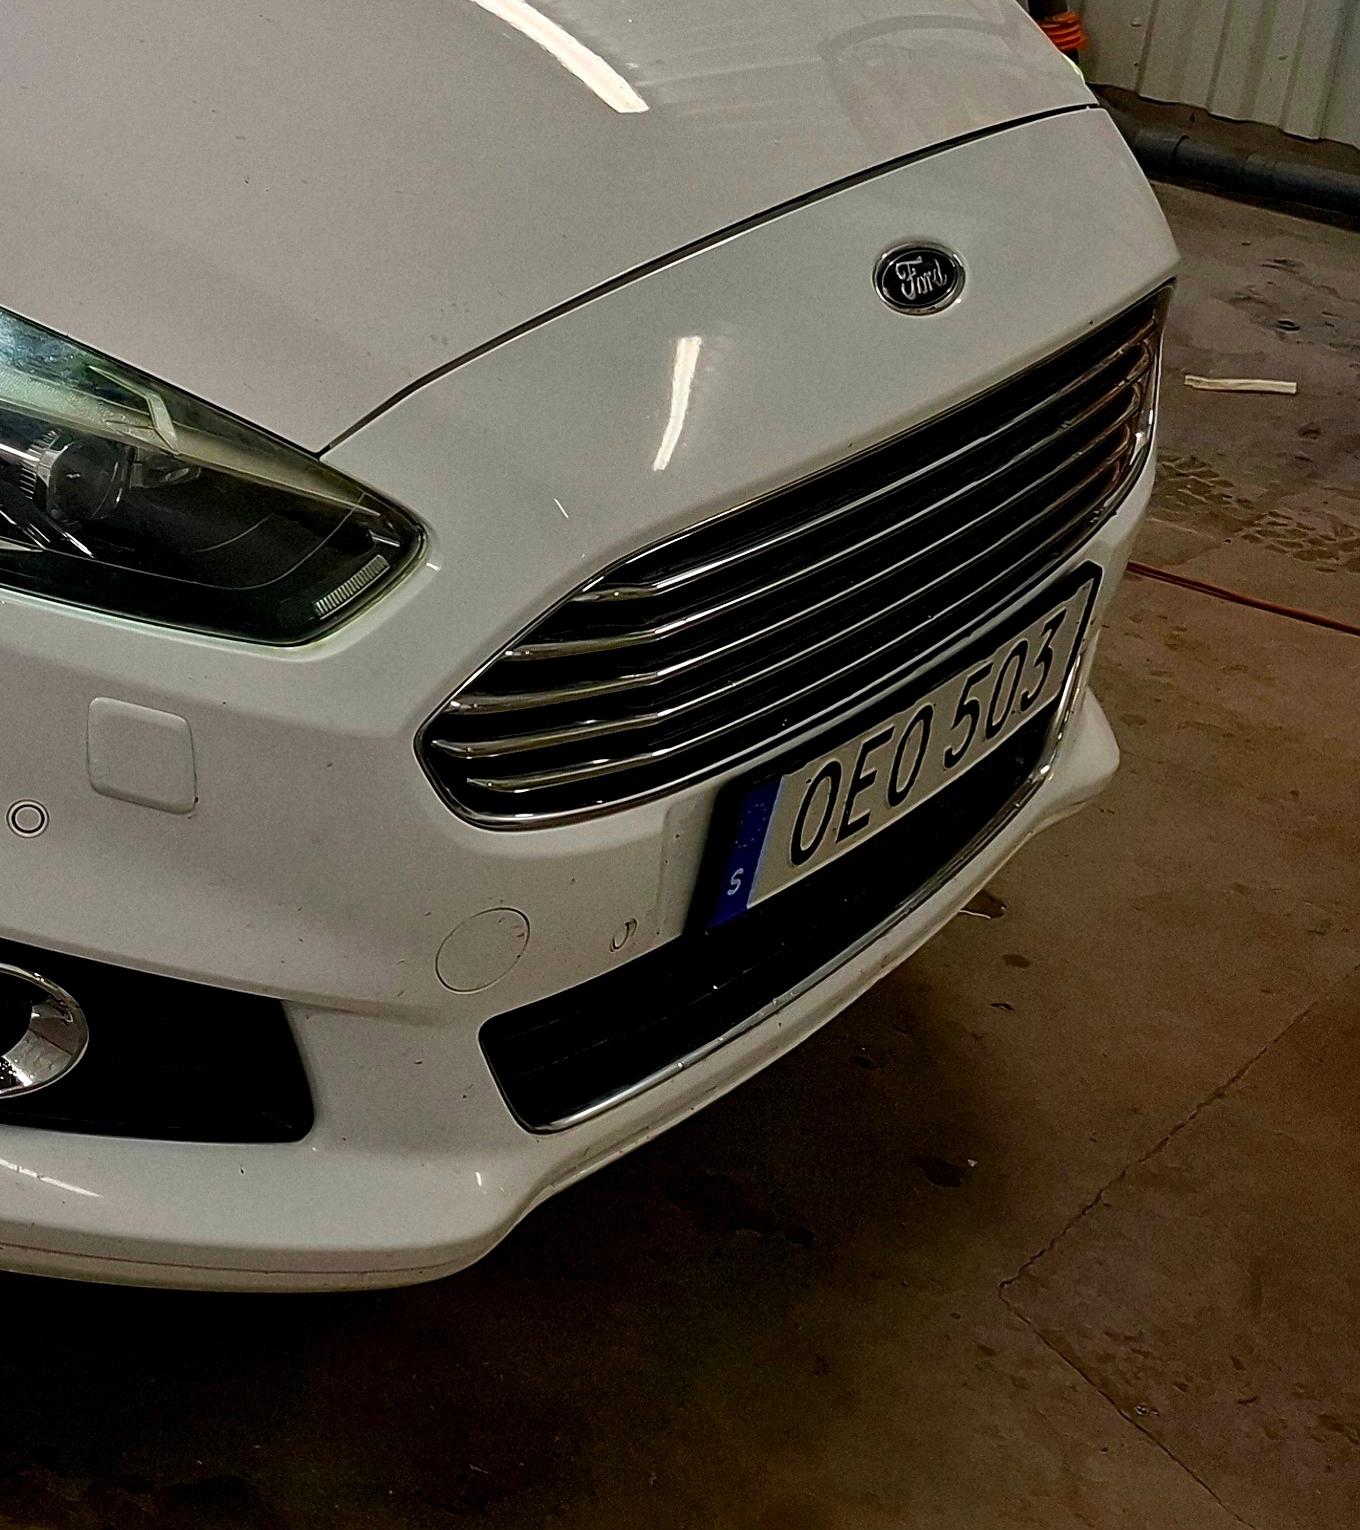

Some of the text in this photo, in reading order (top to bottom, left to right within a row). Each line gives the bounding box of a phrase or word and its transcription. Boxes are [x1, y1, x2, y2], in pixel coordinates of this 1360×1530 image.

[895, 256, 947, 300] Ford
[790, 608, 1067, 866] OEO 503
[727, 868, 744, 896] S
